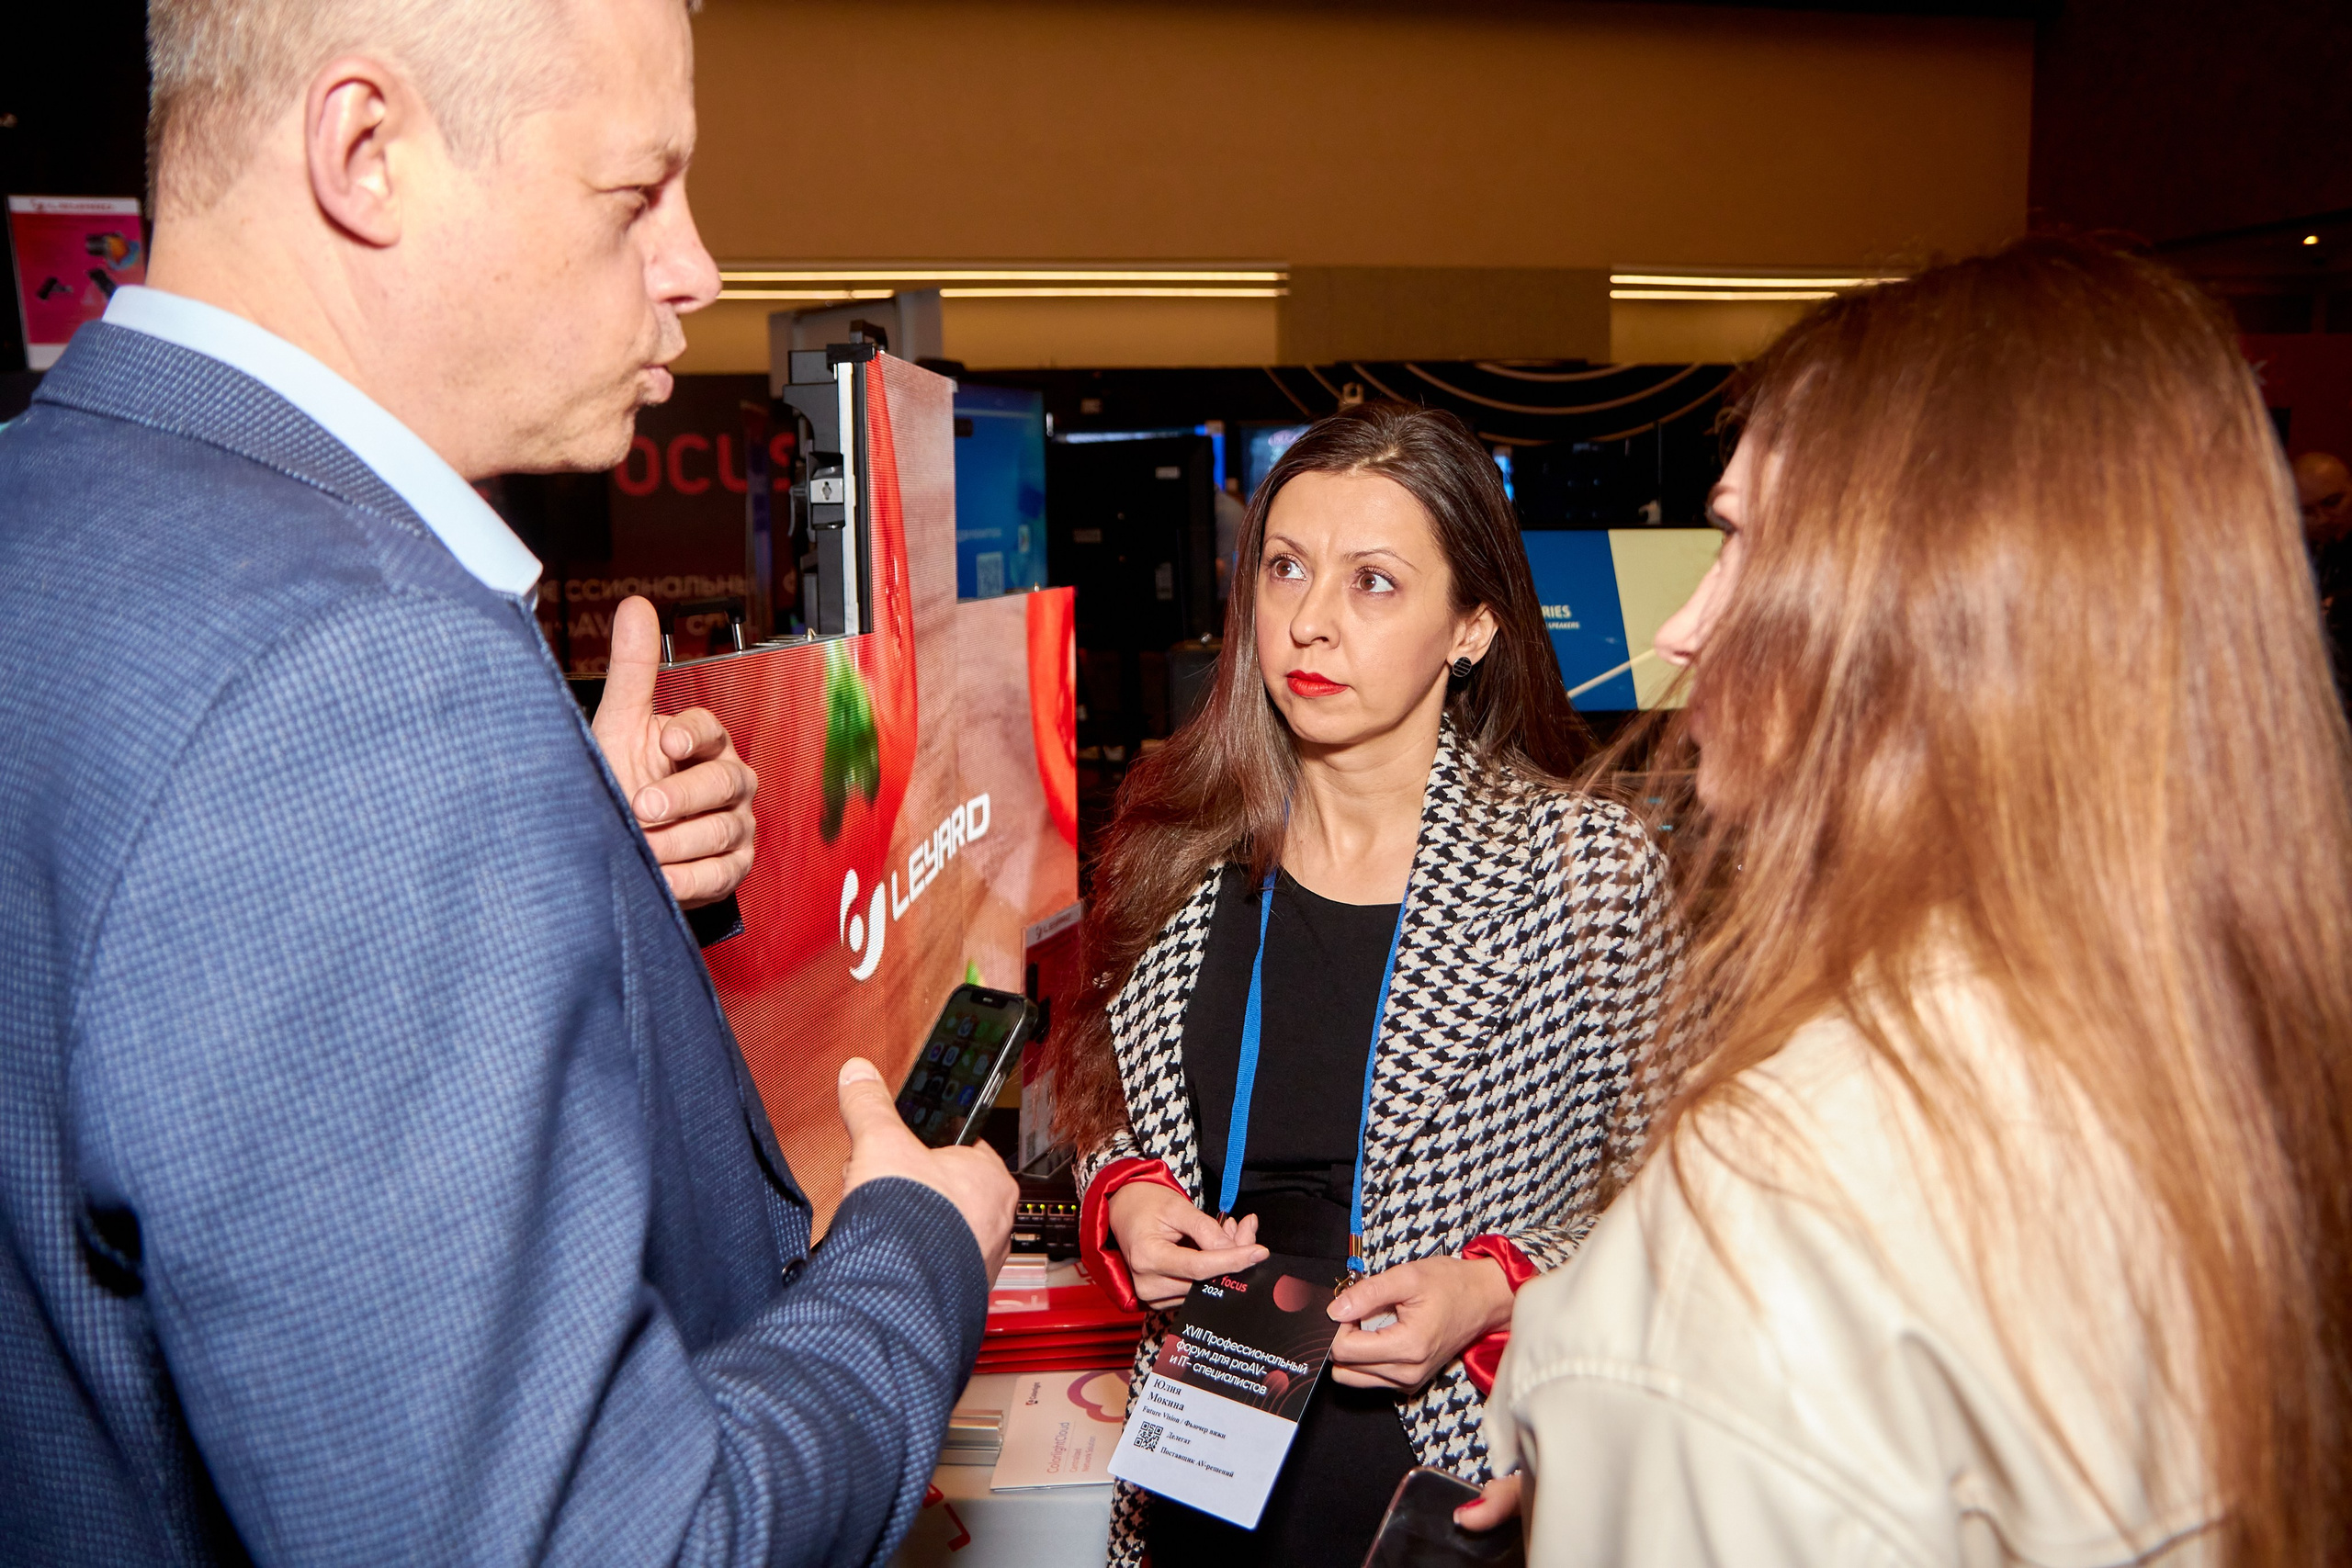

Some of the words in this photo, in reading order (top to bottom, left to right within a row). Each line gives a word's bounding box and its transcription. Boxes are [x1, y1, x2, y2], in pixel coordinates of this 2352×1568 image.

[1542, 604, 1572, 619] RIES
[891, 793, 990, 921] LEYARD
[1201, 1284, 1225, 1297] 2024
[1220, 1275, 1249, 1292] focus
[1175, 1338, 1211, 1362] форум
[1209, 1351, 1231, 1366] для
[1231, 1356, 1269, 1377] proAV-
[1182, 1323, 1204, 1340] XVII
[1203, 1329, 1309, 1374] Профессиональный
[1169, 1354, 1180, 1365] и
[1192, 1362, 1268, 1395] специалистов
[1153, 1378, 1182, 1395] Юлия
[1147, 1391, 1185, 1411] Мокина
[1142, 1405, 1161, 1416] Future
[1163, 1412, 1180, 1424] Vision
[1046, 1422, 1070, 1473] ColorlightCloud
[1166, 1431, 1191, 1445] Делегат
[1160, 1446, 1195, 1464] Поставщик
[1195, 1460, 1235, 1478] AV-решений
